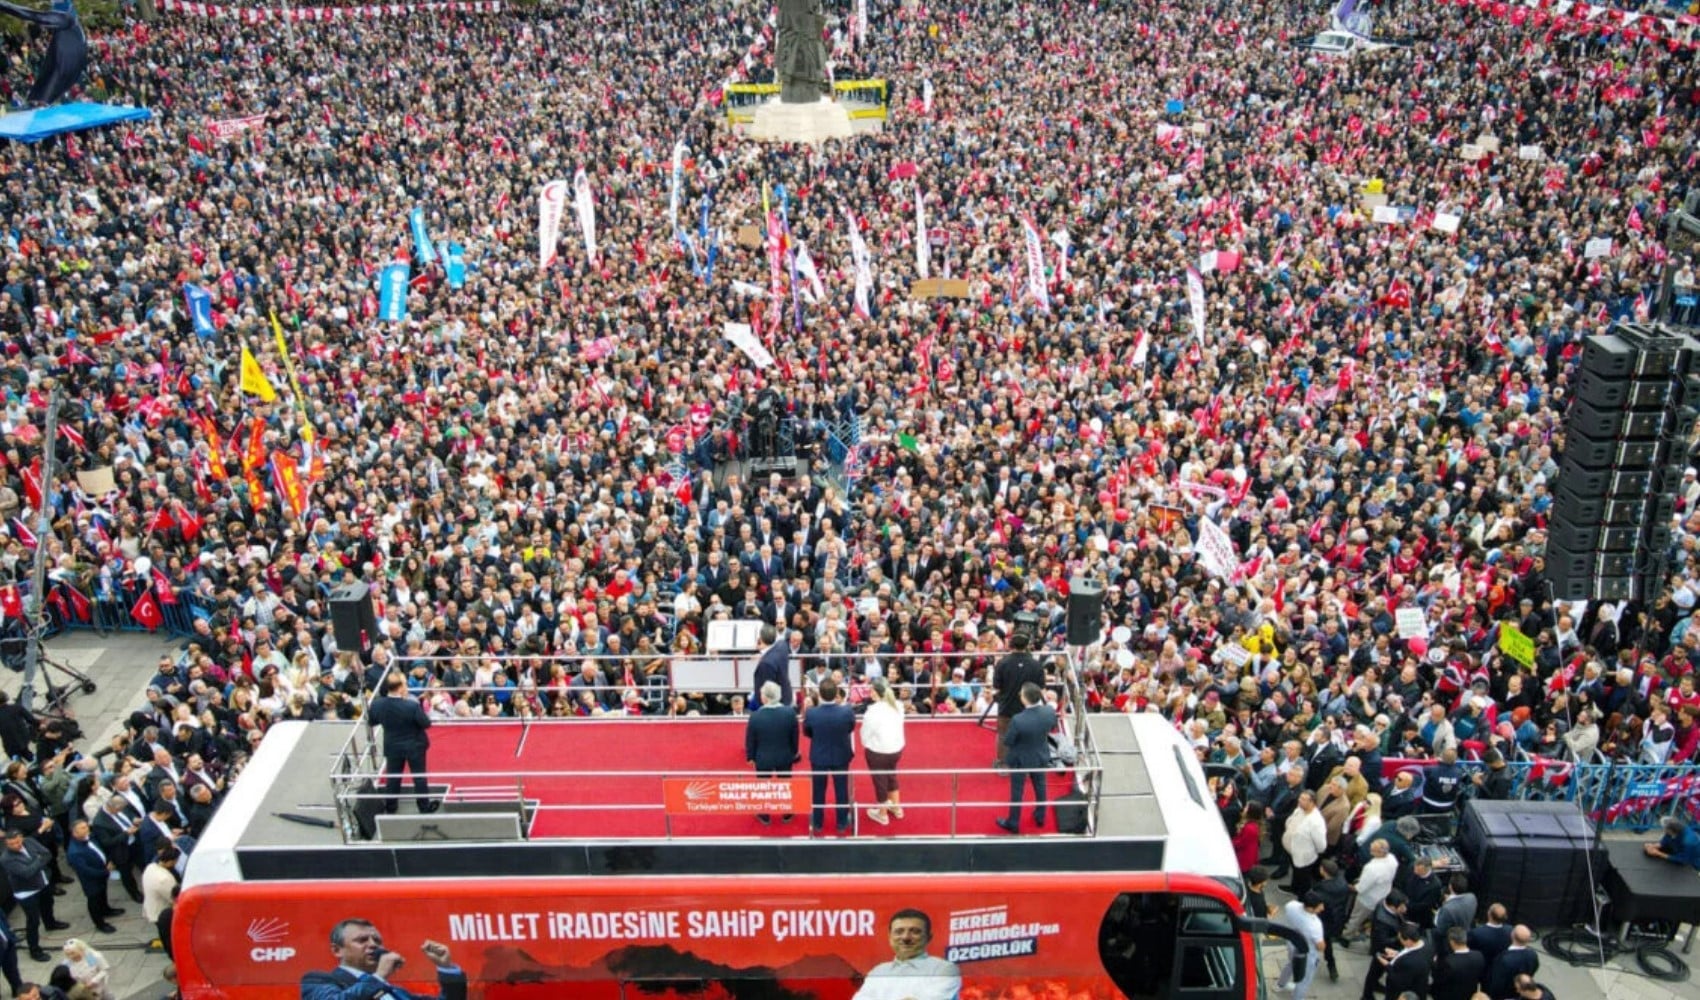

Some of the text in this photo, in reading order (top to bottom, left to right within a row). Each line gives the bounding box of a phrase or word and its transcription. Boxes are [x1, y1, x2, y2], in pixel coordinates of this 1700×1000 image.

[719, 781, 791, 791] CUMHURİYET
[719, 792, 749, 800] HALK
[735, 802, 763, 811] Birinci
[764, 802, 792, 811] Partisi
[772, 909, 875, 942] ÇIKIYOR
[950, 911, 1007, 931] EKREM
[250, 947, 296, 962] CHP
[948, 939, 1033, 962] ÖZGÜRLÜK
